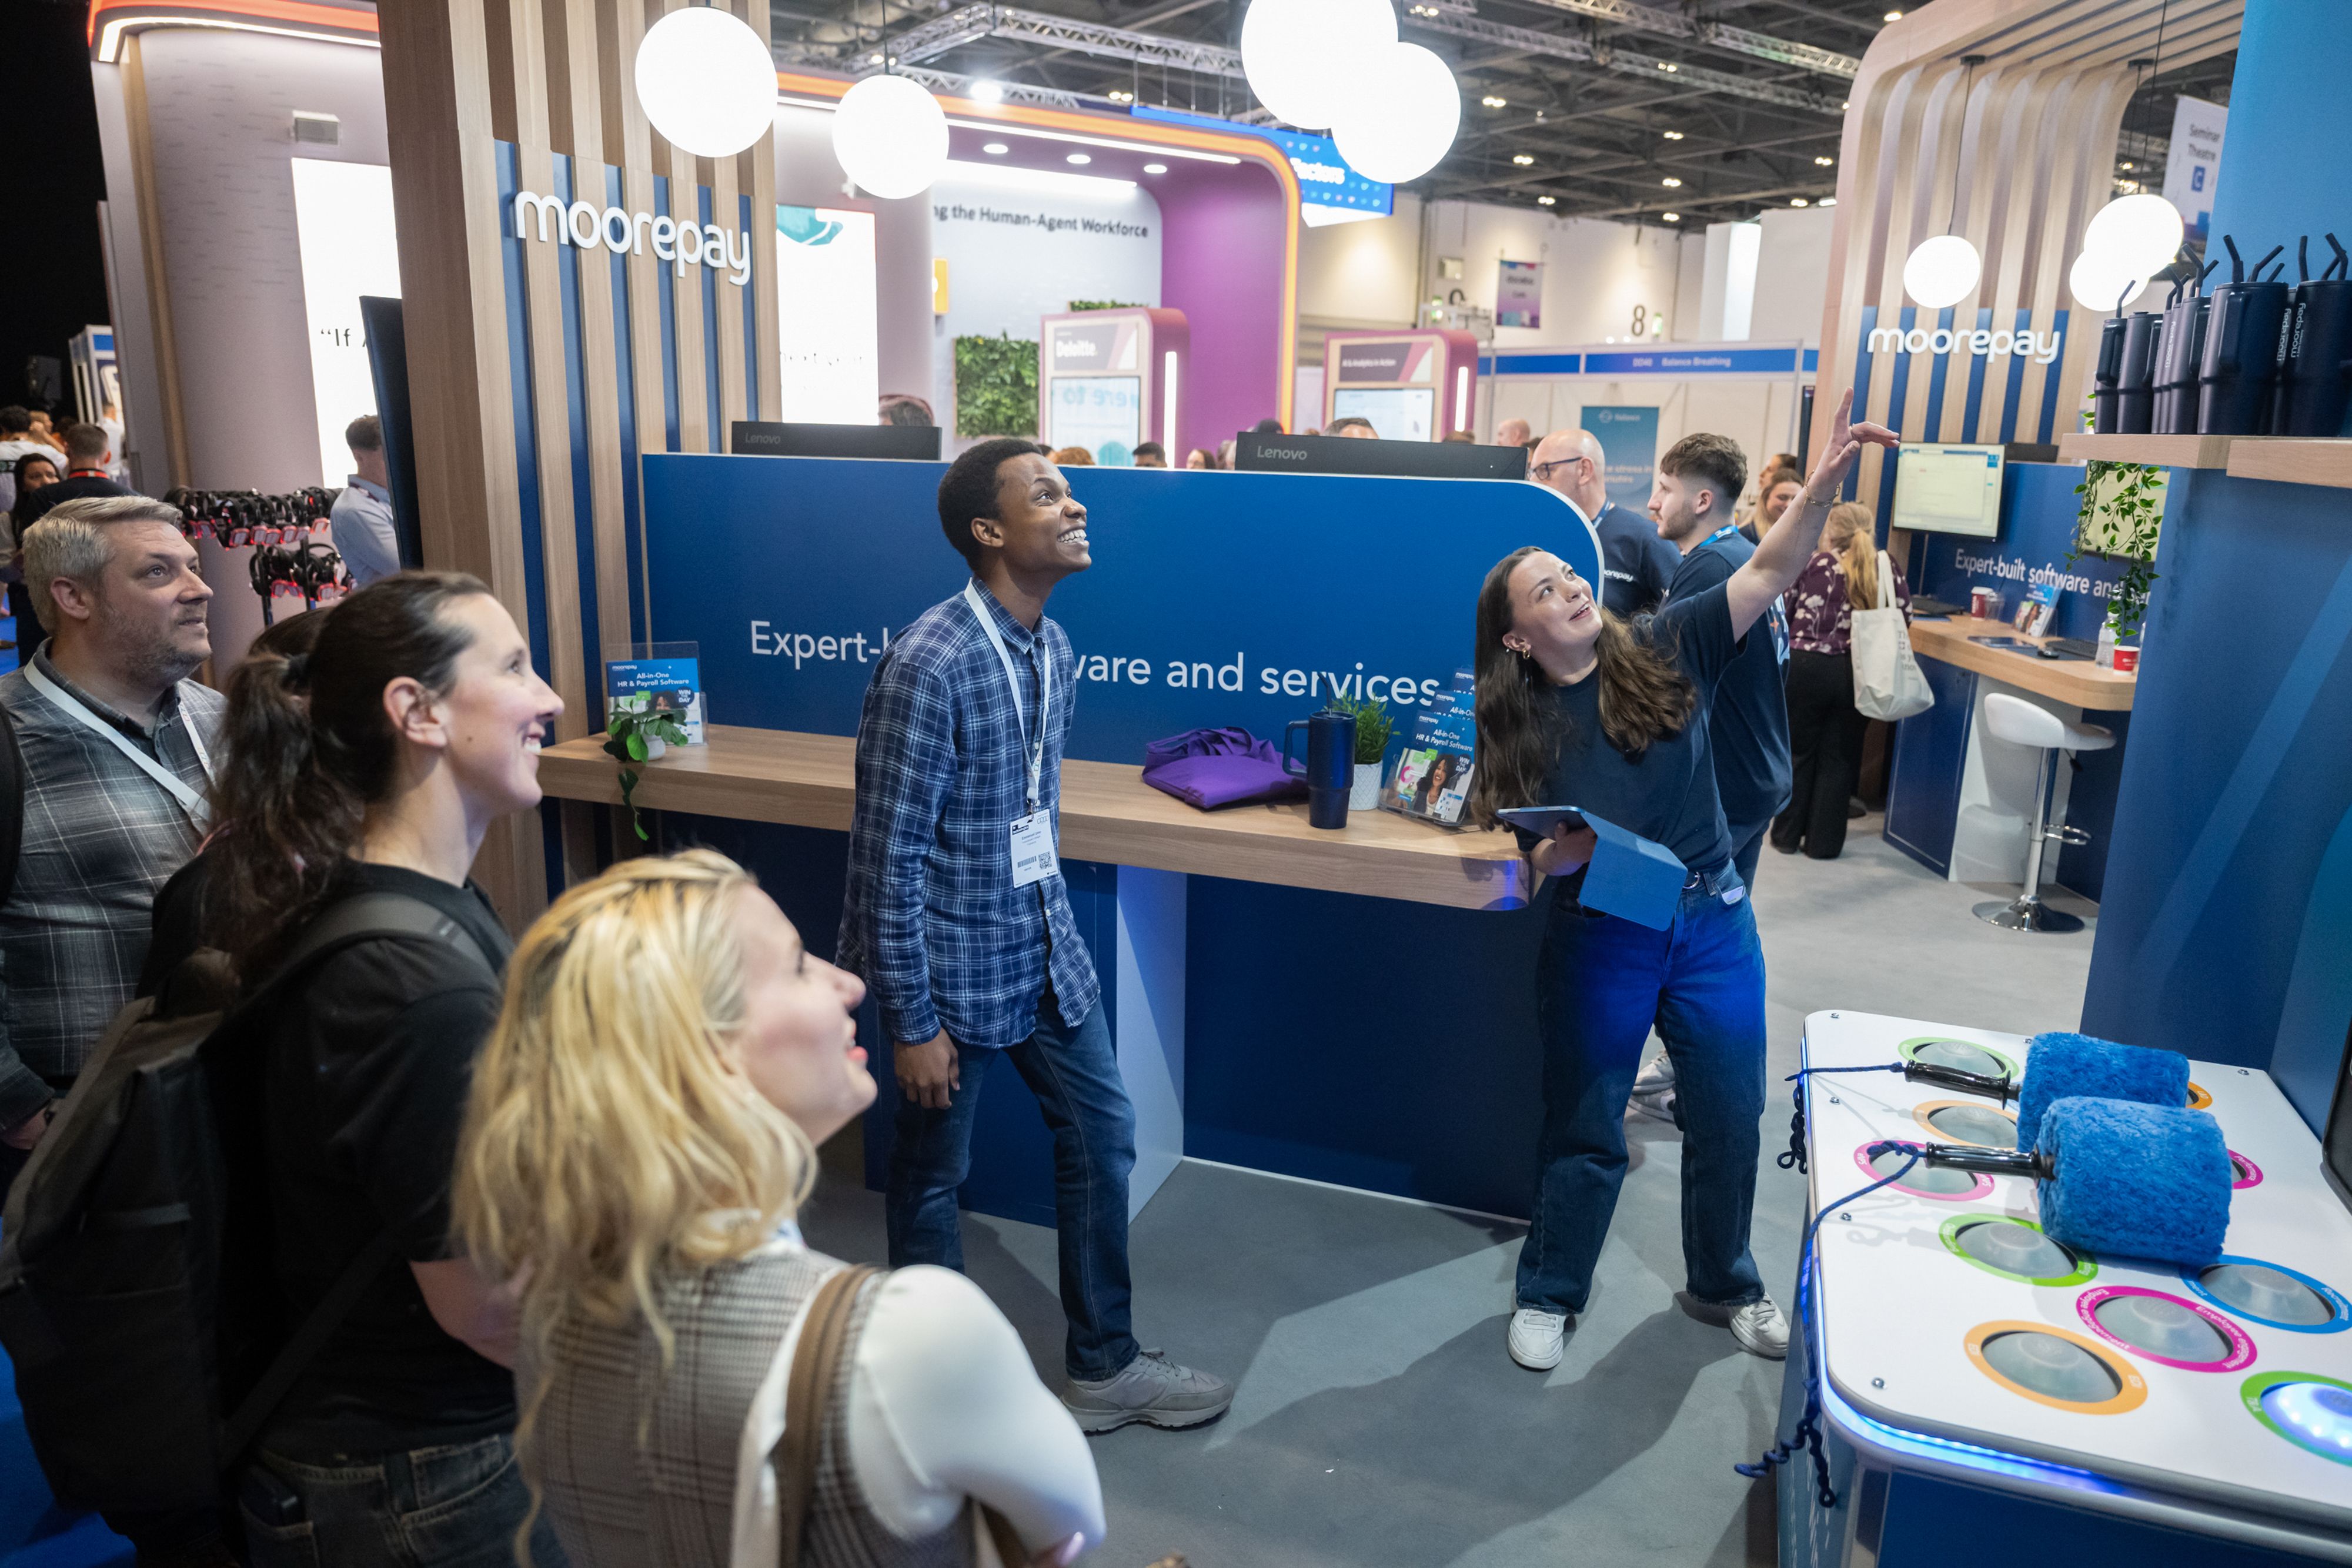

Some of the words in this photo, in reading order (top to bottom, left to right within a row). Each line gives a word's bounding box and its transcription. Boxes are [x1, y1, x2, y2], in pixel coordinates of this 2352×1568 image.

[2189, 123, 2221, 142] Seminar
[2188, 143, 2216, 162] Theatre
[2194, 170, 2203, 188] C
[951, 205, 975, 220] the
[980, 208, 1077, 232] Human-Agent
[1081, 218, 1148, 238] Workforce
[514, 191, 751, 286] moorepay
[1632, 305, 1645, 336] 8
[2291, 303, 2306, 358] moorepay
[2164, 321, 2176, 367] moorepay
[2277, 308, 2291, 360] moorepay
[1866, 327, 2060, 365] moorepay
[745, 433, 781, 444] Lenovo
[1257, 446, 1307, 460] Lenovo
[1604, 570, 1633, 582] orepay
[1955, 549, 2026, 581] Expert-built
[2029, 563, 2090, 594] software
[636, 679, 659, 688] Payroll
[1166, 651, 1244, 692] and
[1259, 662, 1440, 706] services
[1419, 716, 1439, 724] moorepay
[1431, 737, 1449, 746] Payroll
[1449, 740, 1473, 752] Software
[1434, 729, 1460, 740] All-in-One
[1459, 756, 1470, 764] WIN
[2080, 1289, 2110, 1310] Employee
[2081, 1310, 2130, 1350] engagement
[2195, 1305, 2242, 1338] Employee
[2222, 1337, 2250, 1369] engagement
